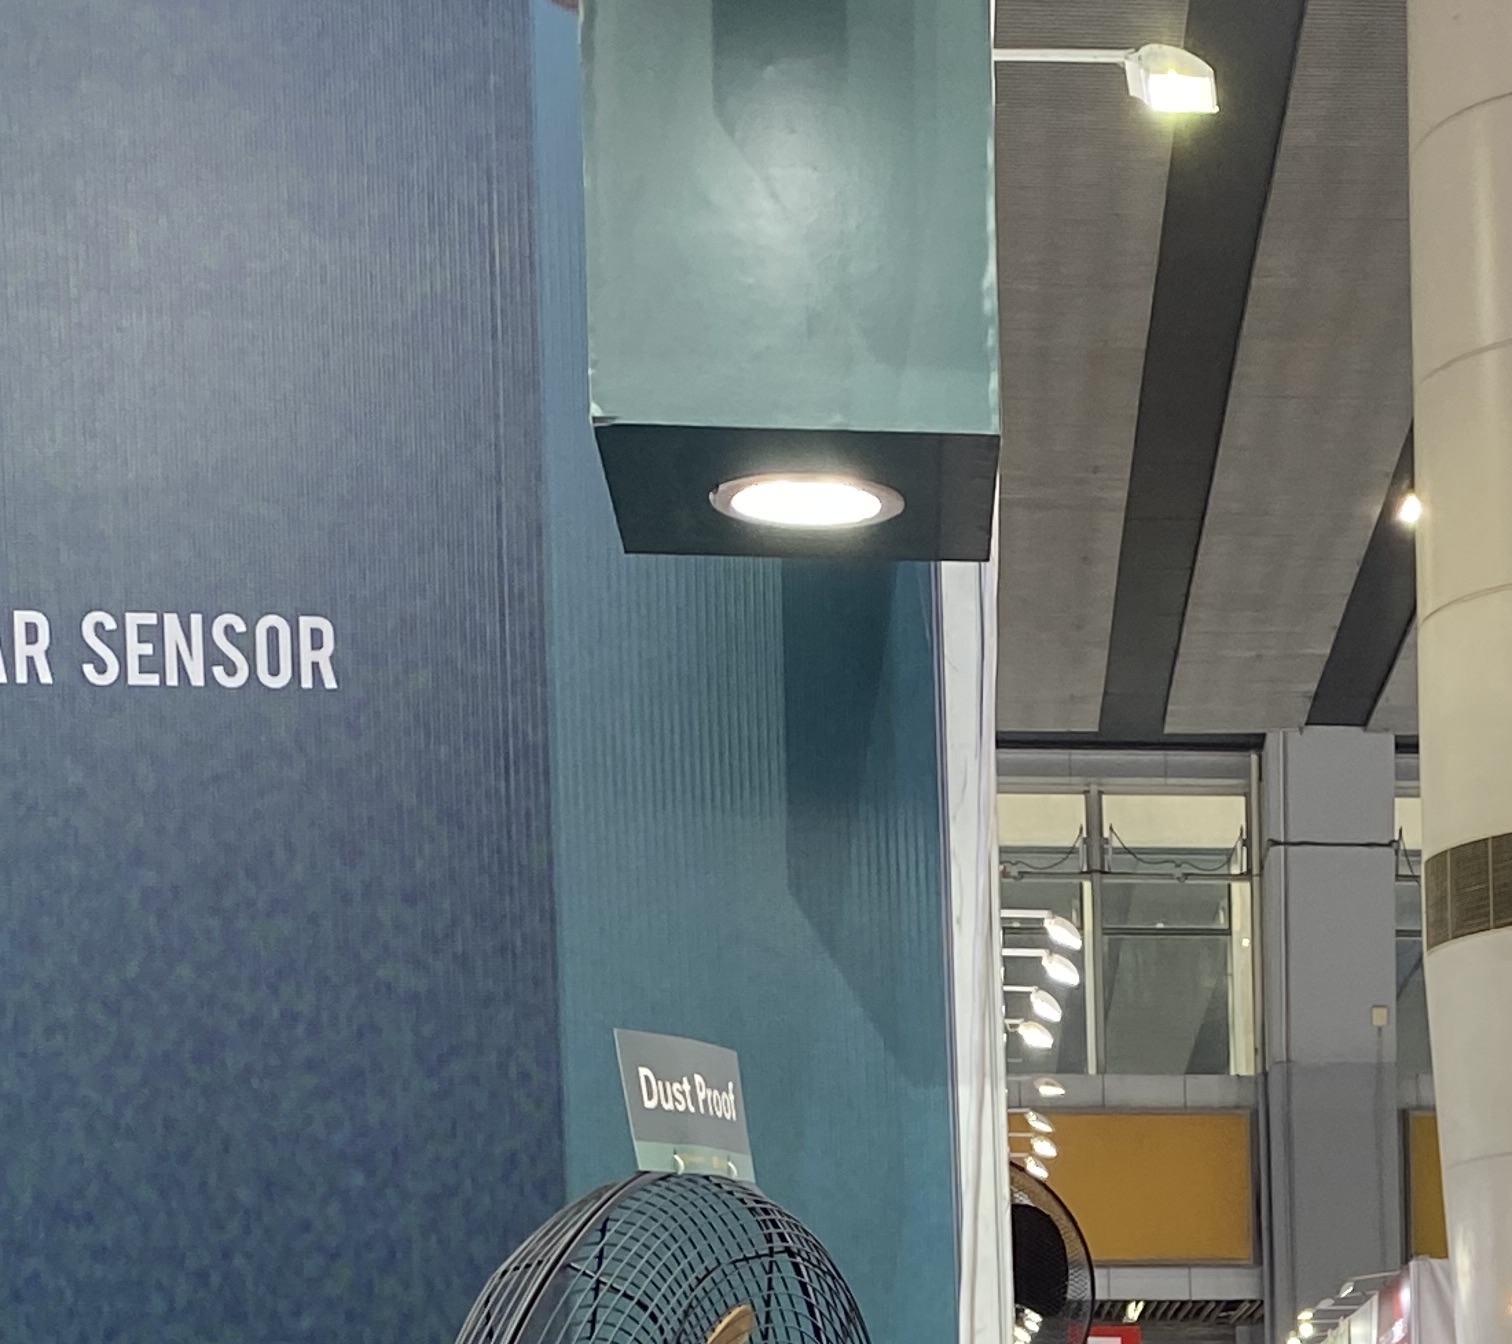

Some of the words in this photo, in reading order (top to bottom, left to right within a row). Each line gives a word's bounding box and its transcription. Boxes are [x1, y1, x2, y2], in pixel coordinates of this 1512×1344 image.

[82, 610, 339, 690] SENSOR
[638, 1066, 695, 1113] Dust
[694, 1073, 737, 1122] Proof
